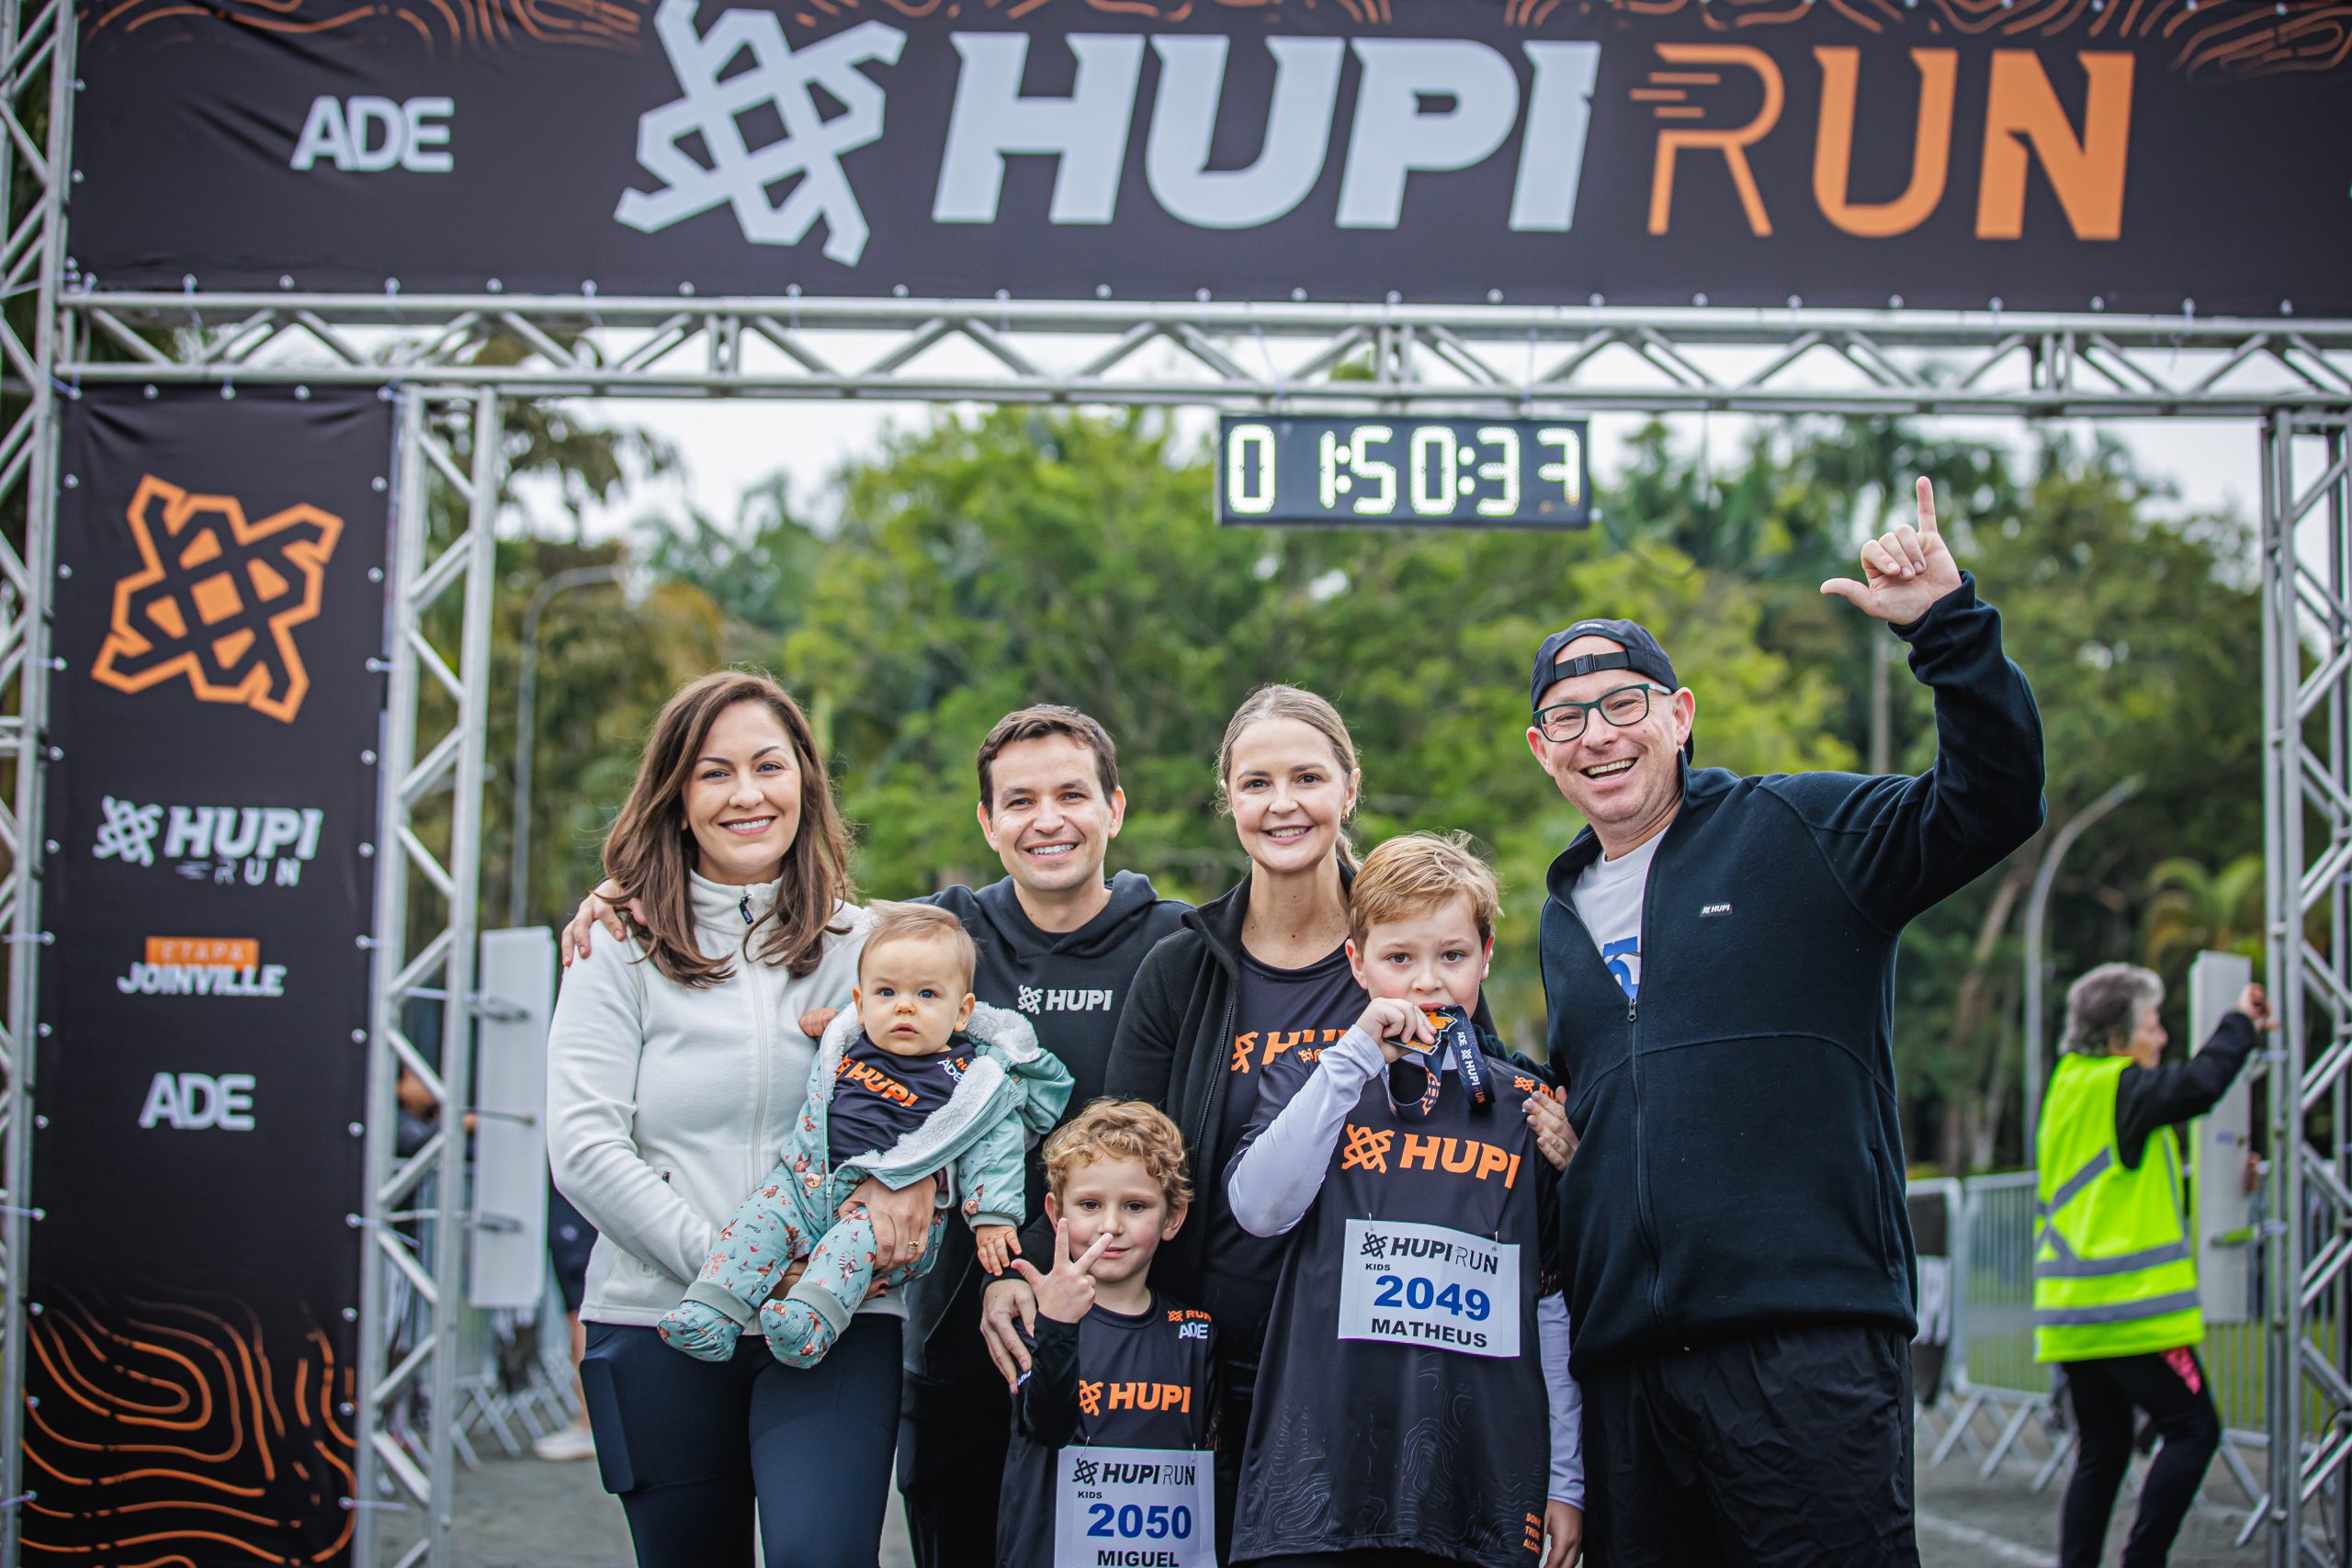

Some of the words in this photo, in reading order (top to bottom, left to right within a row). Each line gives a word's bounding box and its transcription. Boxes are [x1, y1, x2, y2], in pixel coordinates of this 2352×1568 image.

[290, 96, 454, 172] ADE
[931, 31, 1600, 231] HUPI
[1629, 43, 2135, 241] RUN
[164, 806, 323, 861] HUPI
[212, 858, 300, 886] RUN
[1711, 904, 1731, 913] HUPI
[161, 940, 244, 962] ETAPA
[117, 962, 288, 997] JOINVILLE
[1046, 989, 1113, 1010] HUPI
[844, 1061, 919, 1108] HUPI
[1464, 1059, 1480, 1087] HUPI
[138, 1072, 256, 1131] ADE
[1400, 1133, 1521, 1190] HUPI
[1365, 1263, 1391, 1271] KIDS
[1390, 1237, 1453, 1262] HUPI
[1455, 1246, 1498, 1275] RUN
[1374, 1275, 1490, 1321] 2049
[1178, 1322, 1209, 1339] ADE
[1371, 1318, 1487, 1348] MATHEUS
[1108, 1382, 1192, 1414] HUPI
[1102, 1462, 1160, 1484] HUPI
[1162, 1464, 1195, 1485] RUN
[1078, 1491, 1102, 1499] KIDS
[1086, 1503, 1192, 1540] 2050
[1097, 1550, 1180, 1568] MIGUEL
